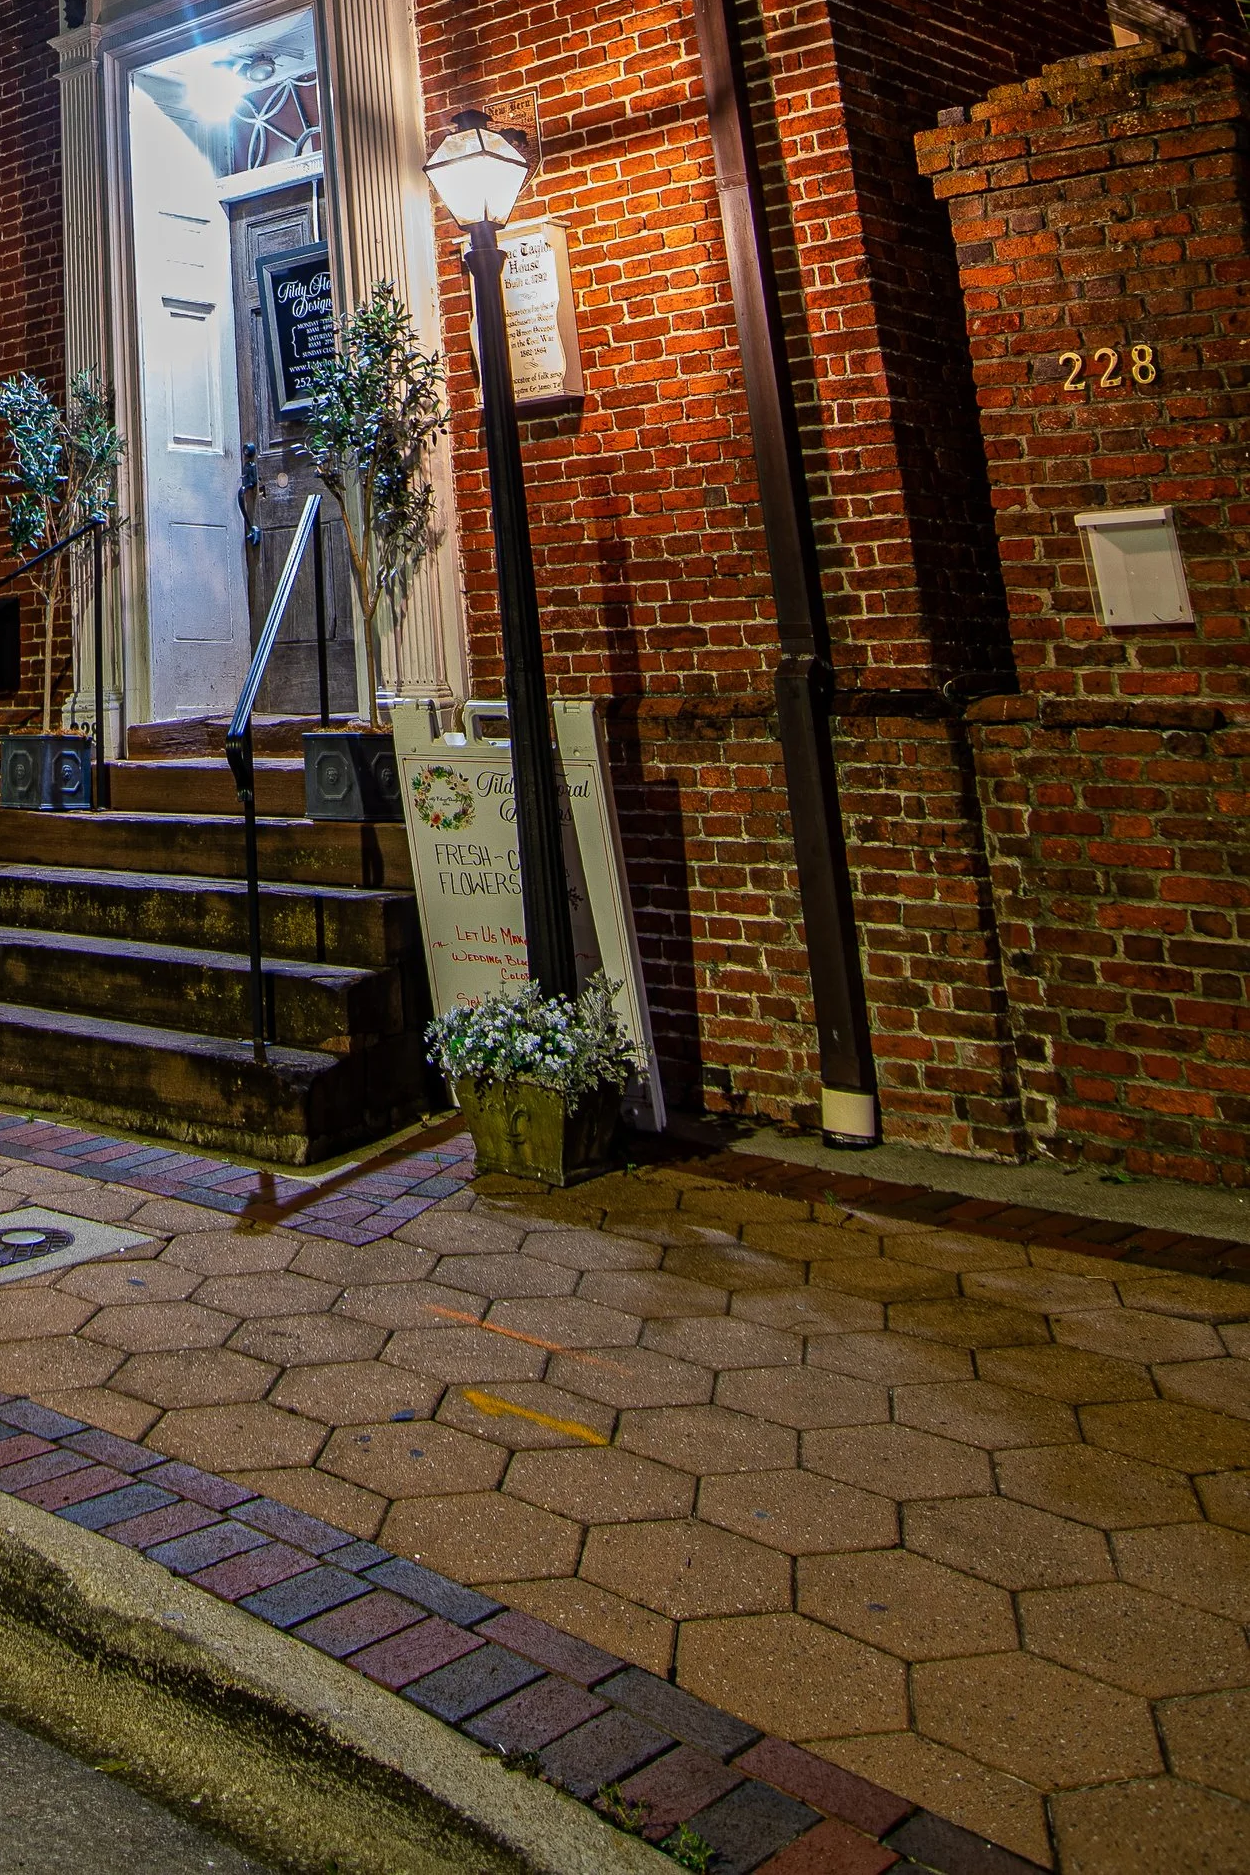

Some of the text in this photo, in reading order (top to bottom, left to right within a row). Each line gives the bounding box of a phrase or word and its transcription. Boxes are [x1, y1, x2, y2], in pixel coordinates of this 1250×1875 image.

[509, 260, 540, 274] House
[277, 279, 307, 303] Tildy
[292, 297, 333, 318] Design
[1059, 344, 1156, 391] 228
[476, 770, 515, 798] Tild
[434, 843, 491, 867] FRESH
[439, 871, 522, 896] FLOWERS
[451, 949, 502, 966] WEDDING
